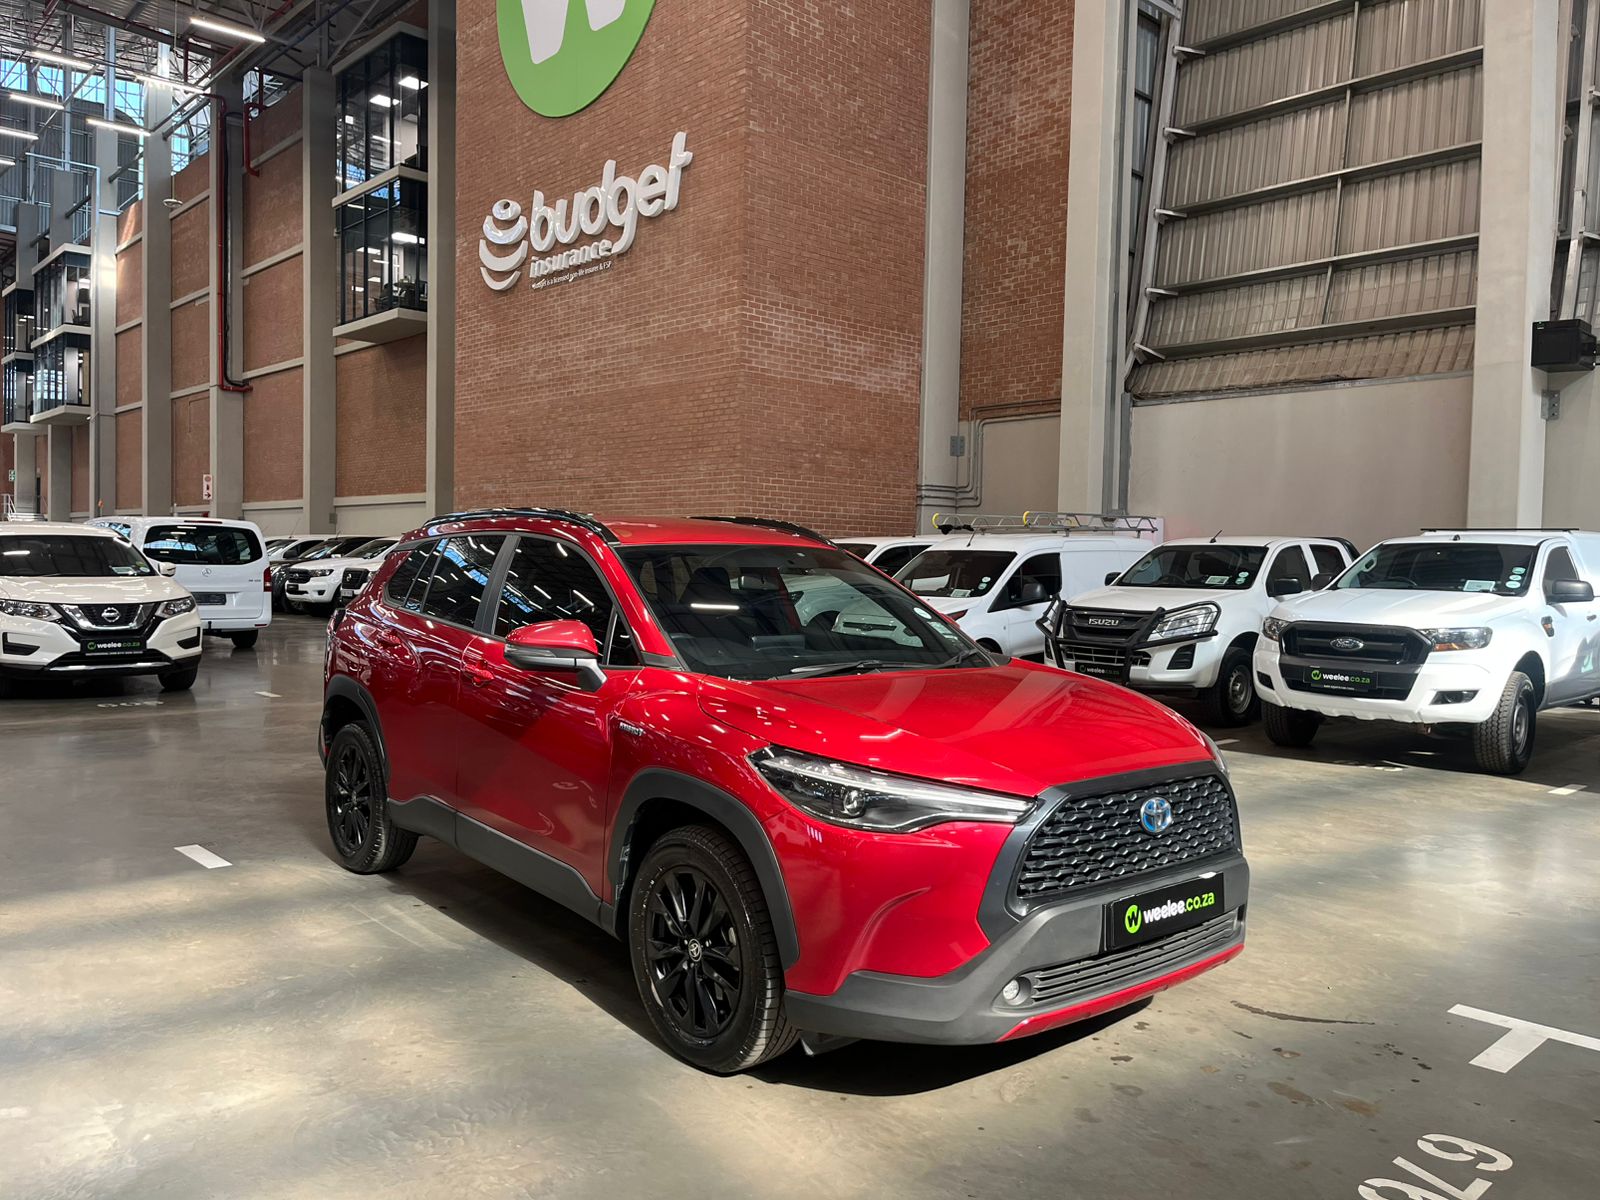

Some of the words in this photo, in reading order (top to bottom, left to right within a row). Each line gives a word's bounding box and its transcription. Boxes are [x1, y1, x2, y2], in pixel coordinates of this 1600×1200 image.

[530, 132, 693, 254] budget
[529, 239, 613, 278] insurance
[1089, 618, 1119, 626] ISUZU
[1323, 673, 1371, 684] weelee.co.za
[1143, 892, 1215, 924] weelee.co.za
